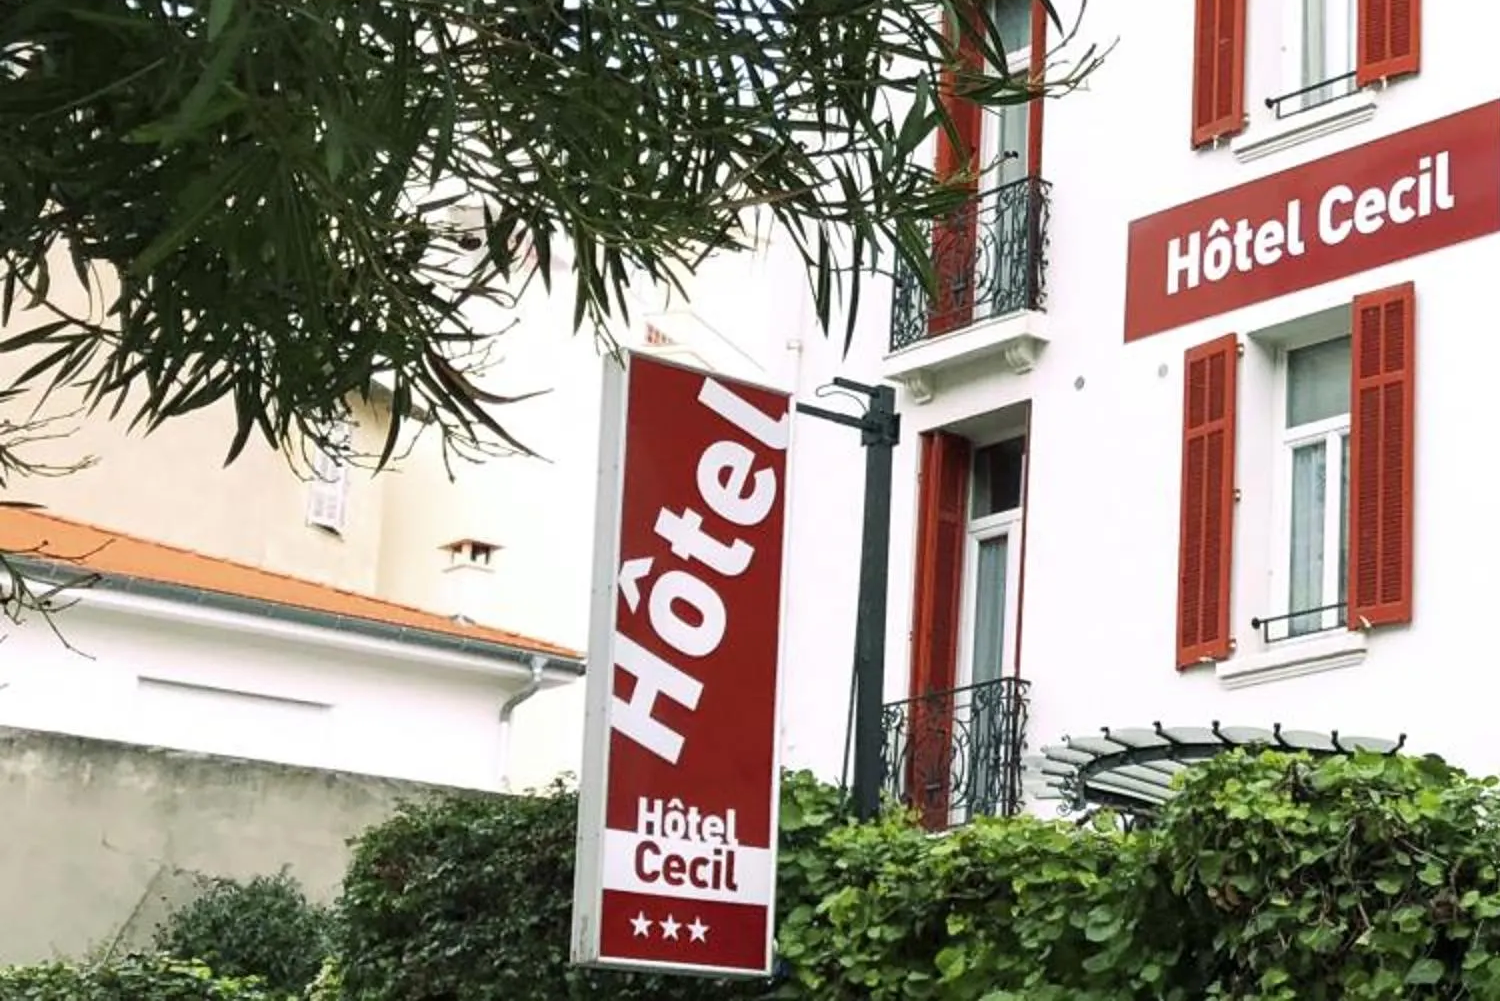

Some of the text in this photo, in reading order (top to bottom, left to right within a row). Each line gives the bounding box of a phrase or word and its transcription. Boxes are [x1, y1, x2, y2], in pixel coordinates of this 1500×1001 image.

[1167, 150, 1455, 295] Hôtel Cecil
[609, 377, 789, 766] Hôtel
[635, 840, 738, 892] Cecil
[638, 796, 738, 845] Hôtel
